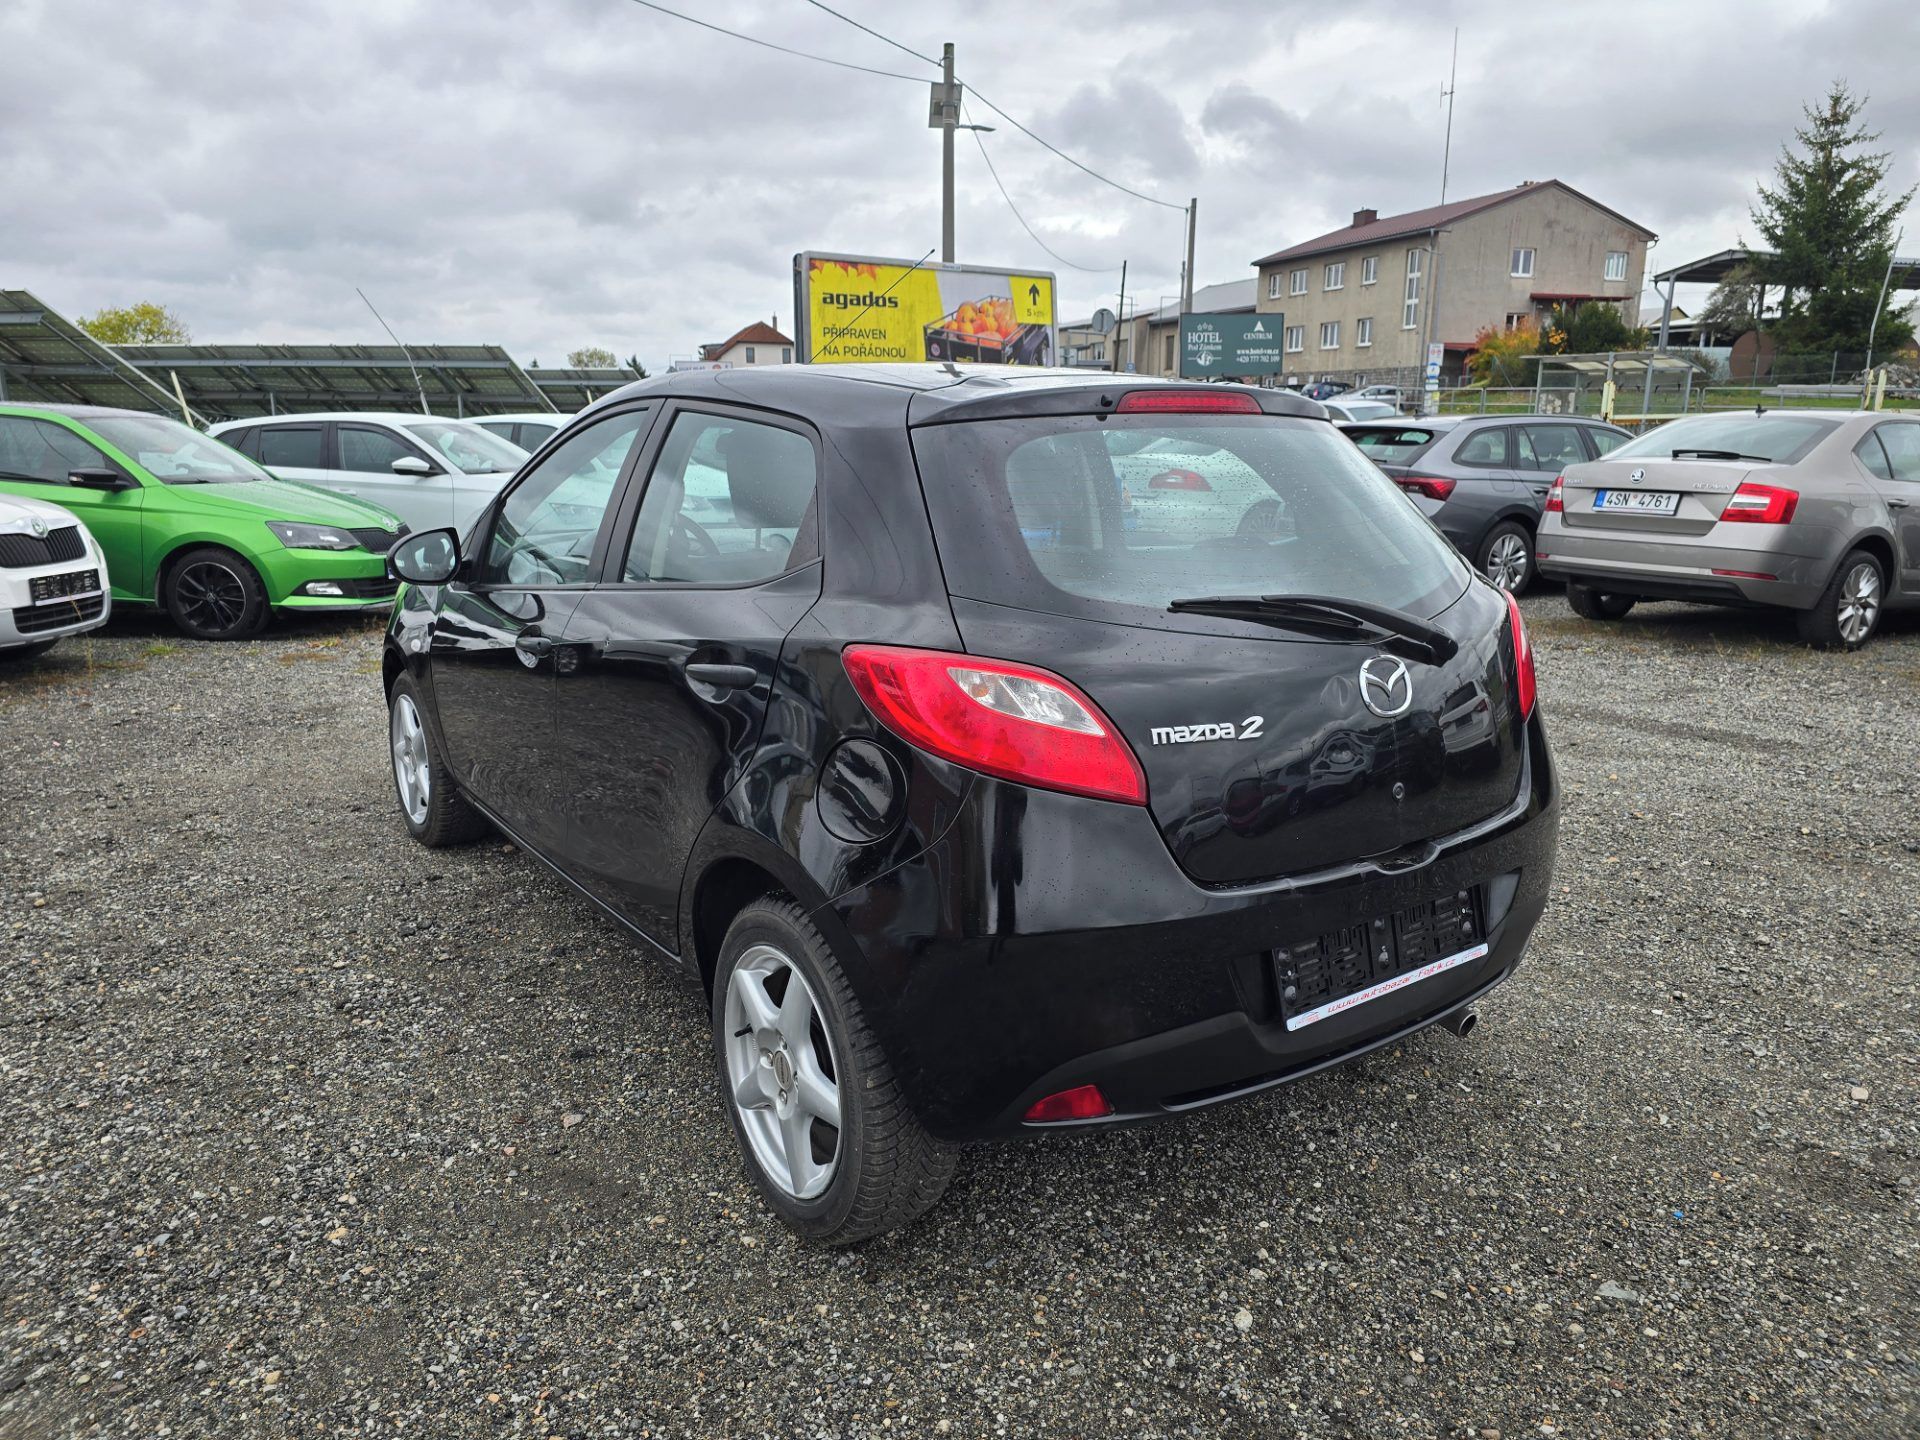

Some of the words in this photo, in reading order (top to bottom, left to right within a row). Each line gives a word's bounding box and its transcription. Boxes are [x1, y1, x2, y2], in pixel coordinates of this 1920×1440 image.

[822, 291, 899, 310] agados
[1026, 308, 1032, 317] 5
[822, 324, 887, 340] PŘIPRAVEN
[1187, 332, 1222, 343] HOTEL
[1243, 332, 1273, 340] CENTRUM
[823, 345, 840, 357] NA
[843, 343, 906, 358] POŘÁDNOU
[1606, 492, 1631, 507] 4SN
[1638, 494, 1672, 509] 4761
[1238, 715, 1264, 740] 2
